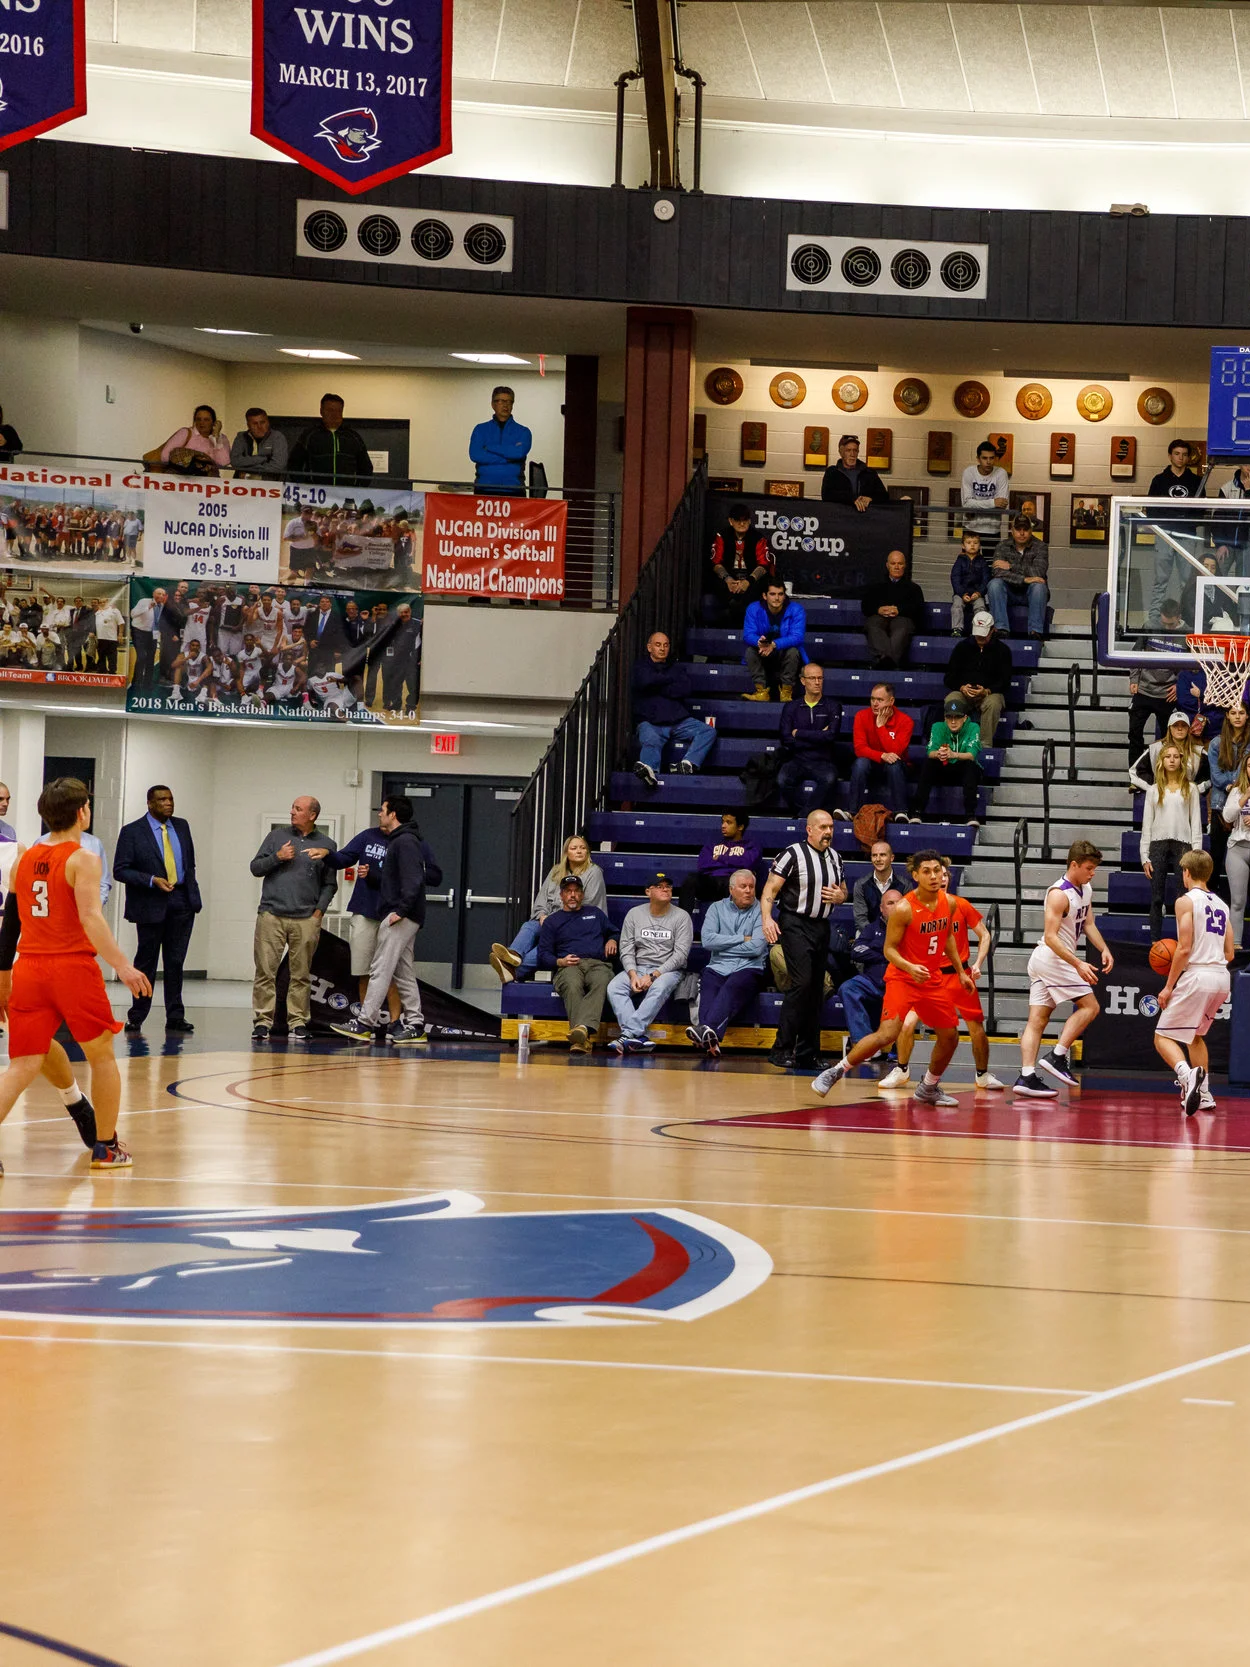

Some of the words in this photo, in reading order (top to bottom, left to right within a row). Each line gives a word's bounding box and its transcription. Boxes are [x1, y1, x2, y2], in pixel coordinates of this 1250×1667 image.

[294, 8, 414, 54] WINS
[0, 33, 44, 56] 2016
[279, 63, 349, 90] MARCH
[356, 72, 381, 96] 13,
[386, 75, 428, 97] 2017
[122, 474, 281, 499] Champions
[283, 486, 327, 504] 45-10
[198, 502, 228, 518] 2005
[476, 500, 511, 517] 2010
[164, 520, 205, 537] NJCAA
[209, 522, 255, 540] Division
[258, 527, 270, 541] III
[435, 519, 484, 538] NJCAA
[487, 522, 541, 540] Division
[544, 525, 557, 542] III
[754, 510, 819, 535] Hoop
[163, 541, 218, 558] Women's
[222, 543, 270, 561] Softball
[439, 540, 500, 559] Women's
[503, 544, 555, 562] Softball
[771, 531, 844, 556] Group
[191, 562, 237, 578] 49-8-1
[426, 562, 485, 591] National
[488, 567, 564, 600] Champions
[9, 672, 32, 680] Team!
[57, 675, 111, 684] BROOKDALE
[131, 697, 162, 710] 2018
[165, 697, 205, 713] Men's
[208, 701, 275, 716] Basketball
[277, 703, 331, 719] National
[334, 707, 387, 721] Champs
[388, 709, 417, 721] 34-0
[435, 736, 456, 752] EXIT
[32, 880, 49, 917] 3
[920, 918, 948, 934] NORTH
[1204, 905, 1226, 937] 23
[928, 936, 938, 955] 5
